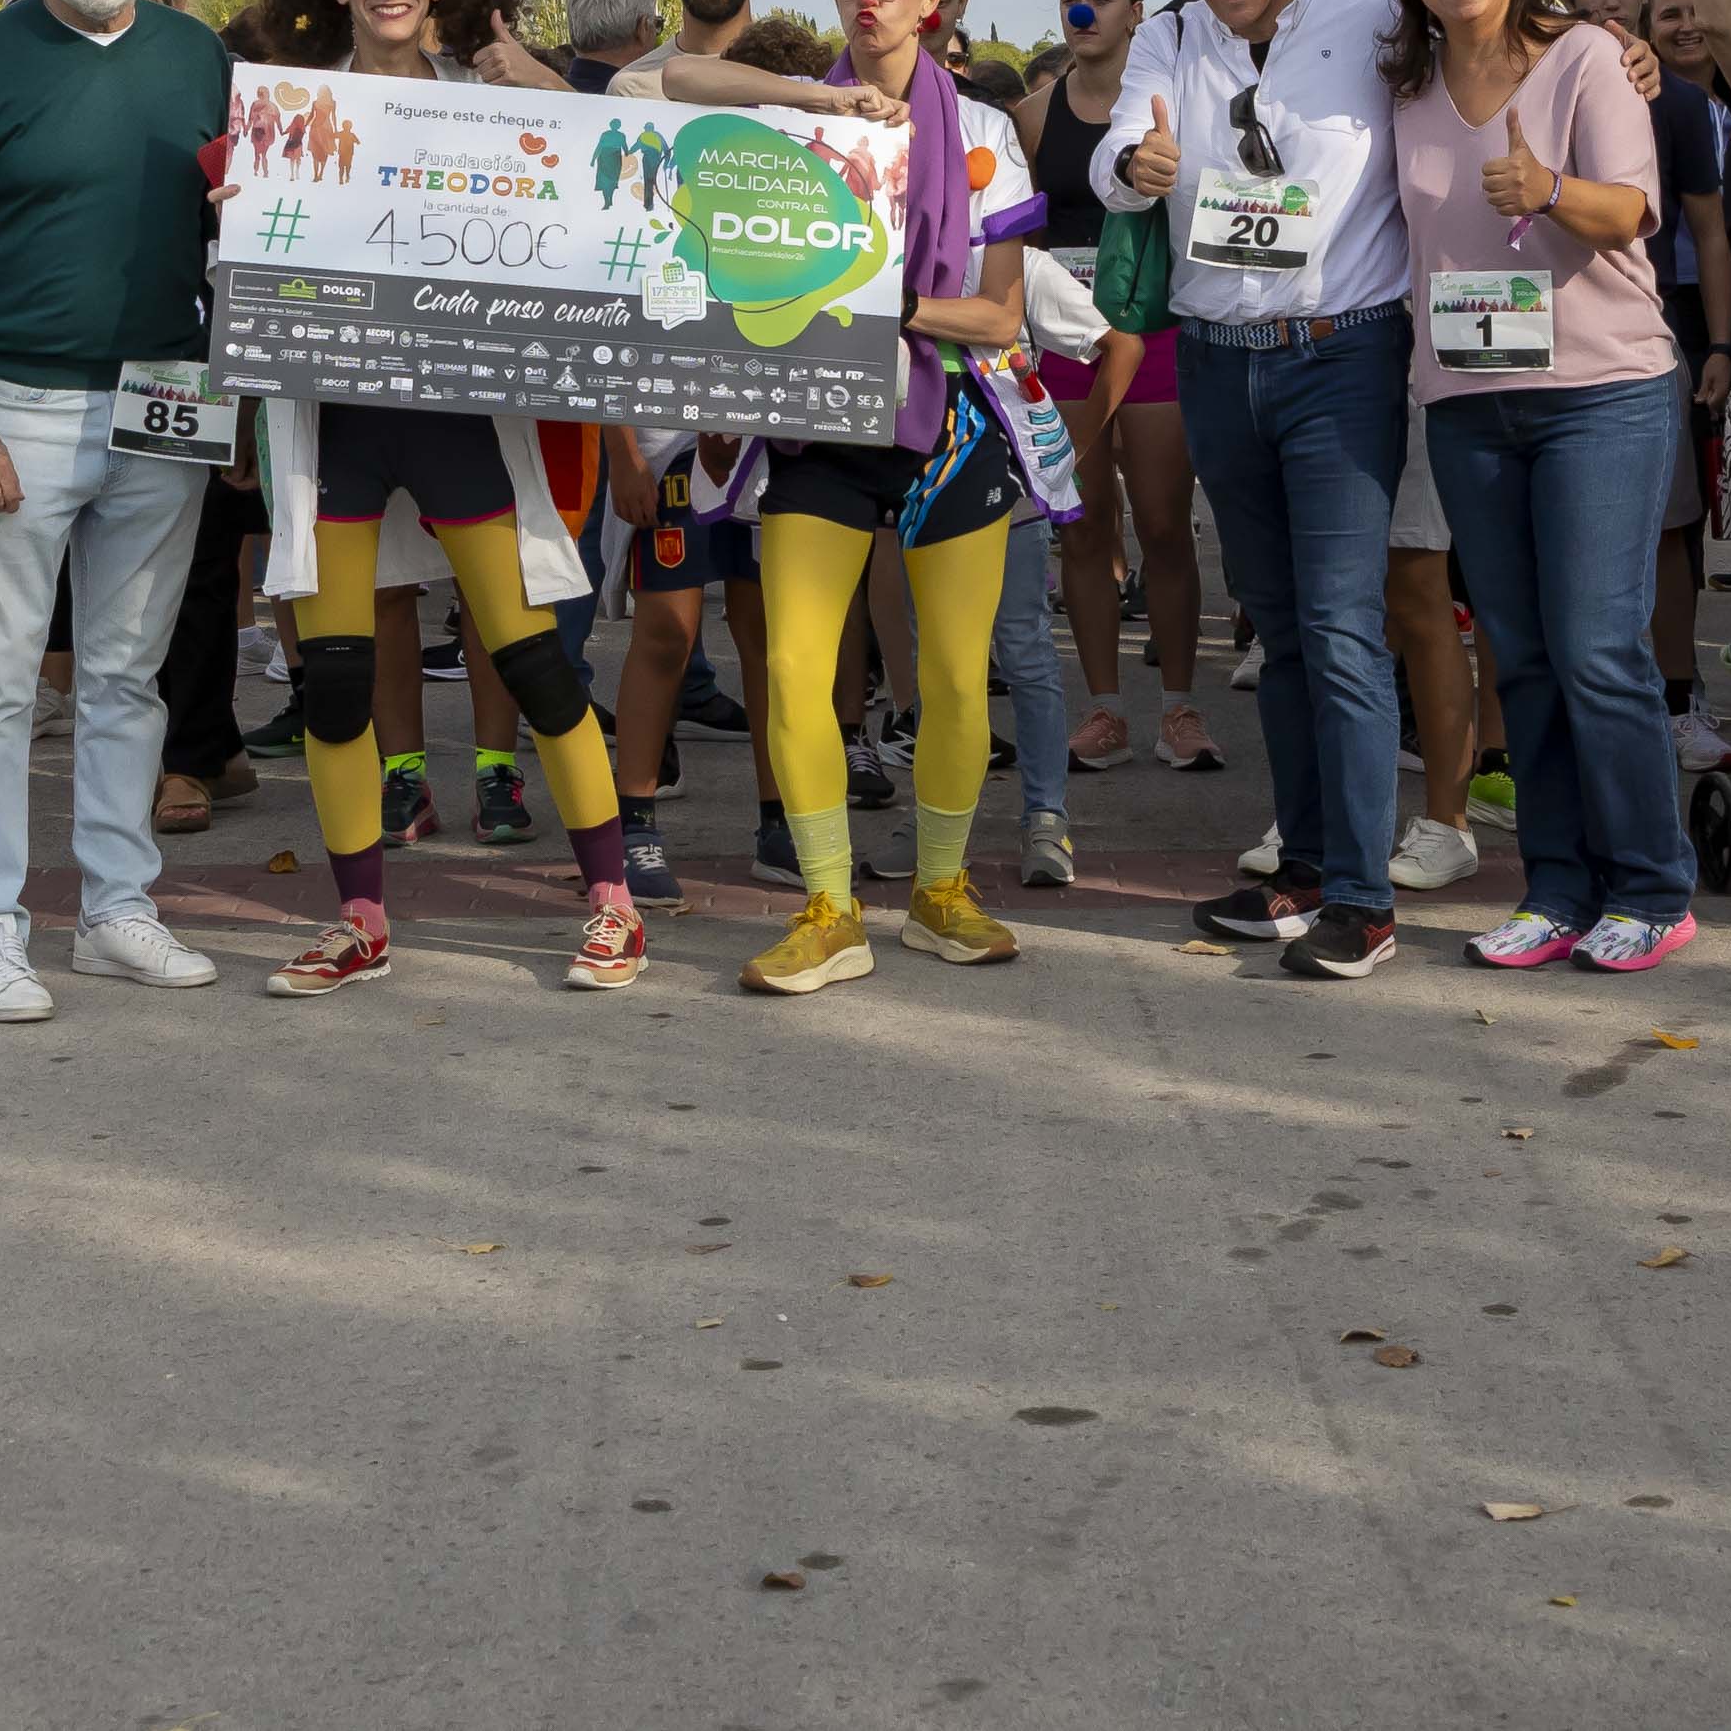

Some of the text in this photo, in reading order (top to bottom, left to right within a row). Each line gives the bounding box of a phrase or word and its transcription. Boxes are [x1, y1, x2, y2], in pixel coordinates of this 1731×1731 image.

[384, 102, 562, 130] Páguese este cheque a:
[413, 148, 526, 174] Fundación
[698, 149, 809, 173] MARCHA
[378, 165, 559, 200] THEODORA
[697, 171, 829, 198] SOLIDARIA
[423, 199, 434, 210] la
[436, 200, 489, 215] cantidad
[756, 198, 829, 215] CONTRA EL
[711, 211, 875, 254] DOLOR
[1227, 214, 1280, 247] 20
[413, 284, 480, 316] Cada
[486, 298, 545, 325] paso
[553, 297, 632, 328] cuenta
[1476, 314, 1492, 347] 1
[143, 400, 199, 437] 85
[664, 474, 689, 508] 10
